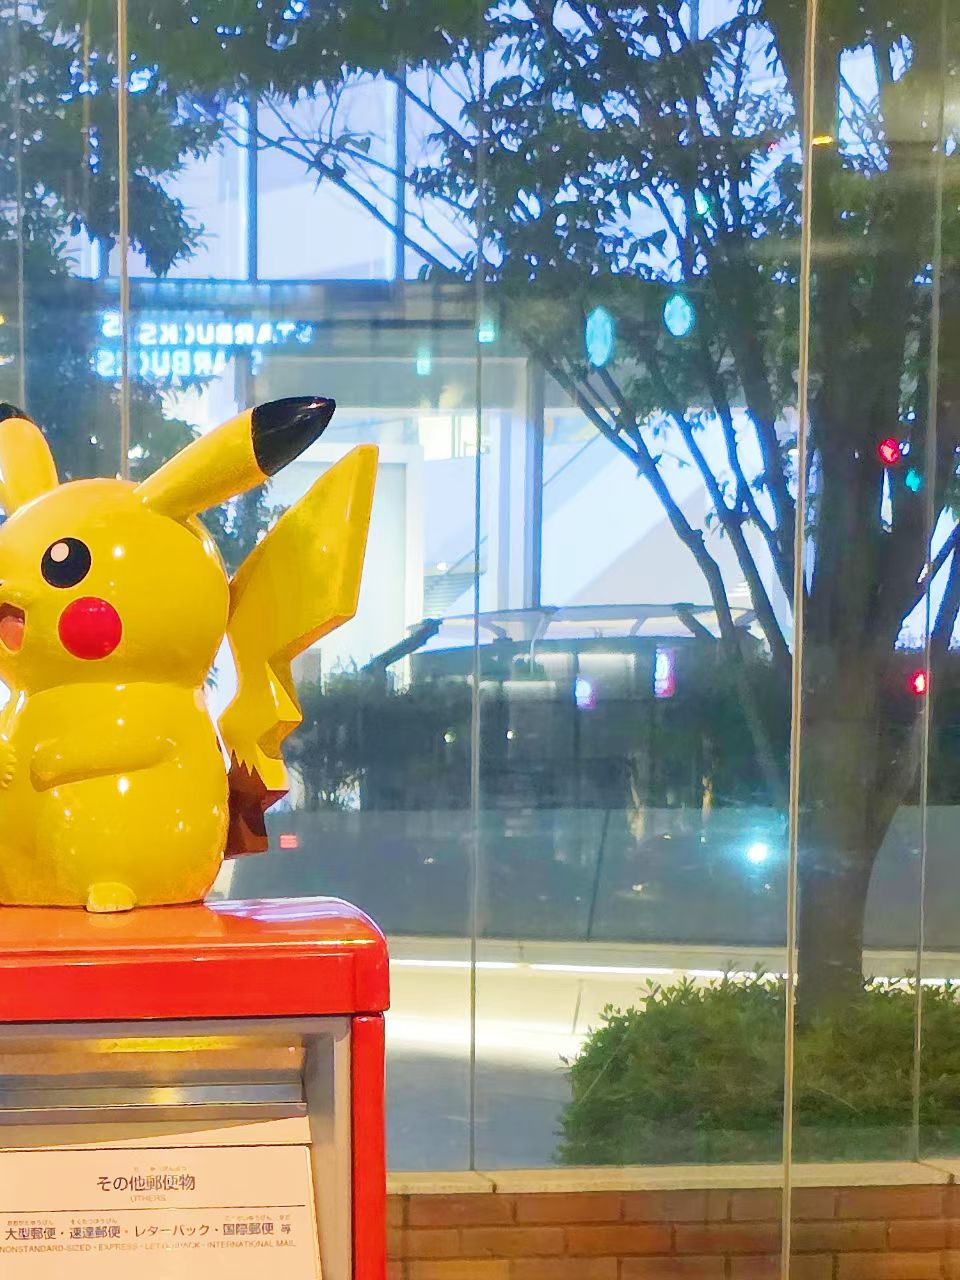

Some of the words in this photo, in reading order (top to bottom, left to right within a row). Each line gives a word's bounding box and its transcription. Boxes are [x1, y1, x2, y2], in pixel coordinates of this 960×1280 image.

[96, 1174, 196, 1191] その他郵便物
